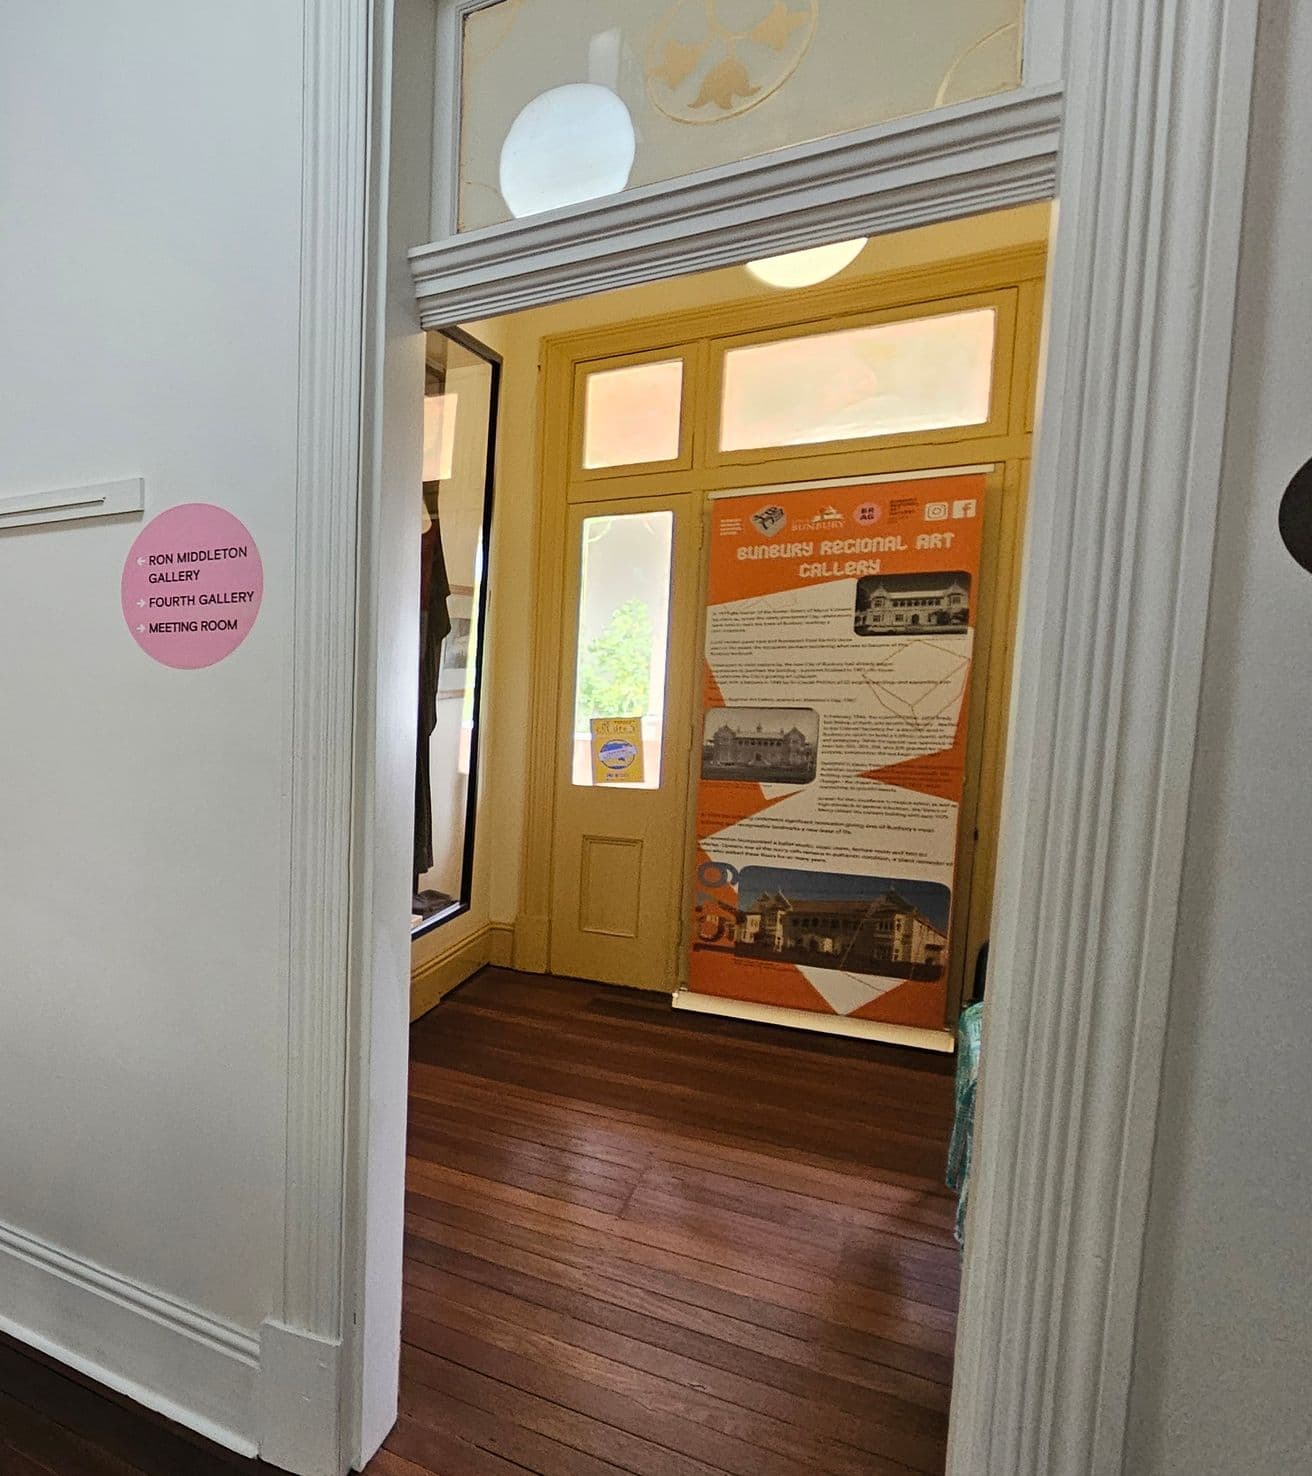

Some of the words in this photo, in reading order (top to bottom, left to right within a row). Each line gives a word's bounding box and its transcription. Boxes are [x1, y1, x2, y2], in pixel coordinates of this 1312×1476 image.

[736, 542, 814, 560] BUNBURY
[915, 532, 955, 550] ART
[148, 553, 174, 566] RON
[176, 546, 248, 563] MIDDLETON
[148, 569, 200, 584] GALLERY
[798, 558, 881, 578] GALLERY
[149, 595, 196, 608] FOURTH
[198, 590, 255, 606] GALLERY
[149, 620, 198, 633] MEETING
[200, 619, 238, 631] ROOM
